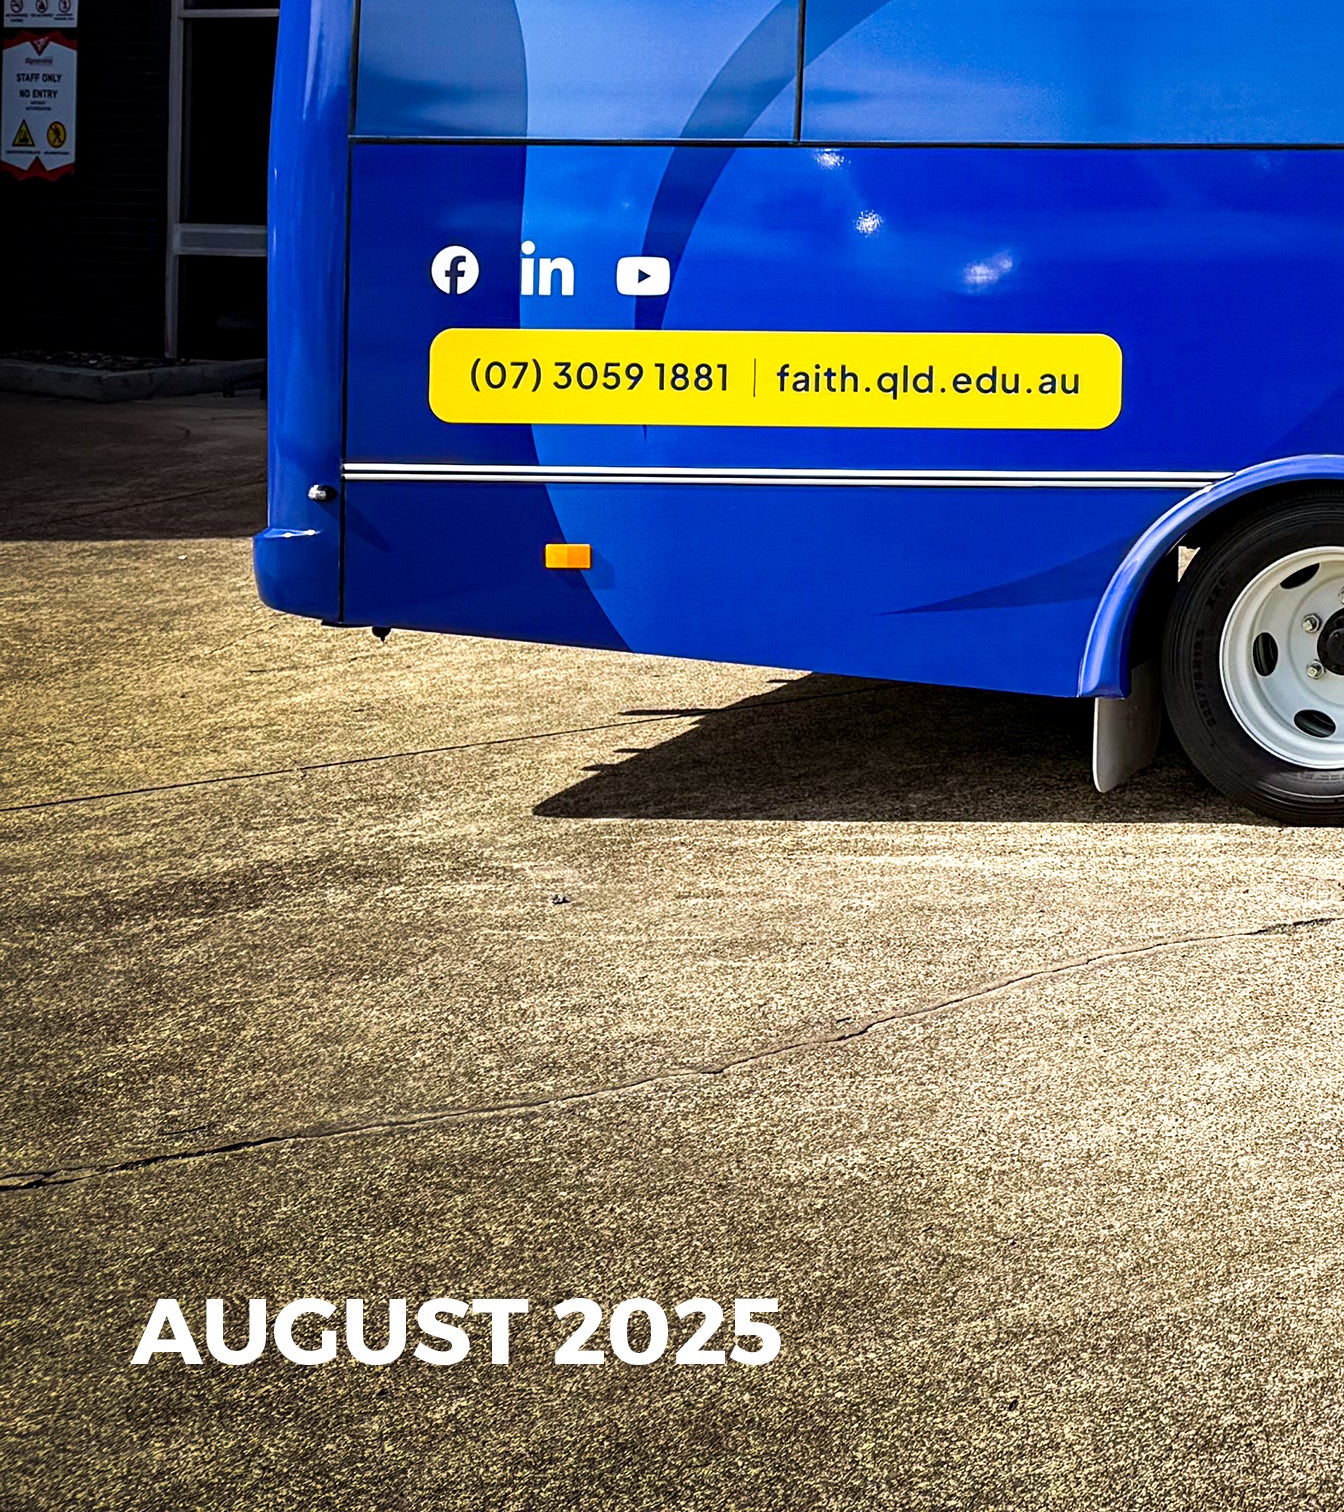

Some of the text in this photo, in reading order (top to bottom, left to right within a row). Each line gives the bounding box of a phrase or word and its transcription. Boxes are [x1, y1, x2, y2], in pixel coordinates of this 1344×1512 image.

[16, 72, 62, 83] STAFF ONLY
[19, 89, 58, 99] NO ENTRY
[470, 358, 727, 393] (07) 3059 1881
[776, 363, 1080, 400] faith.qld.edu.au
